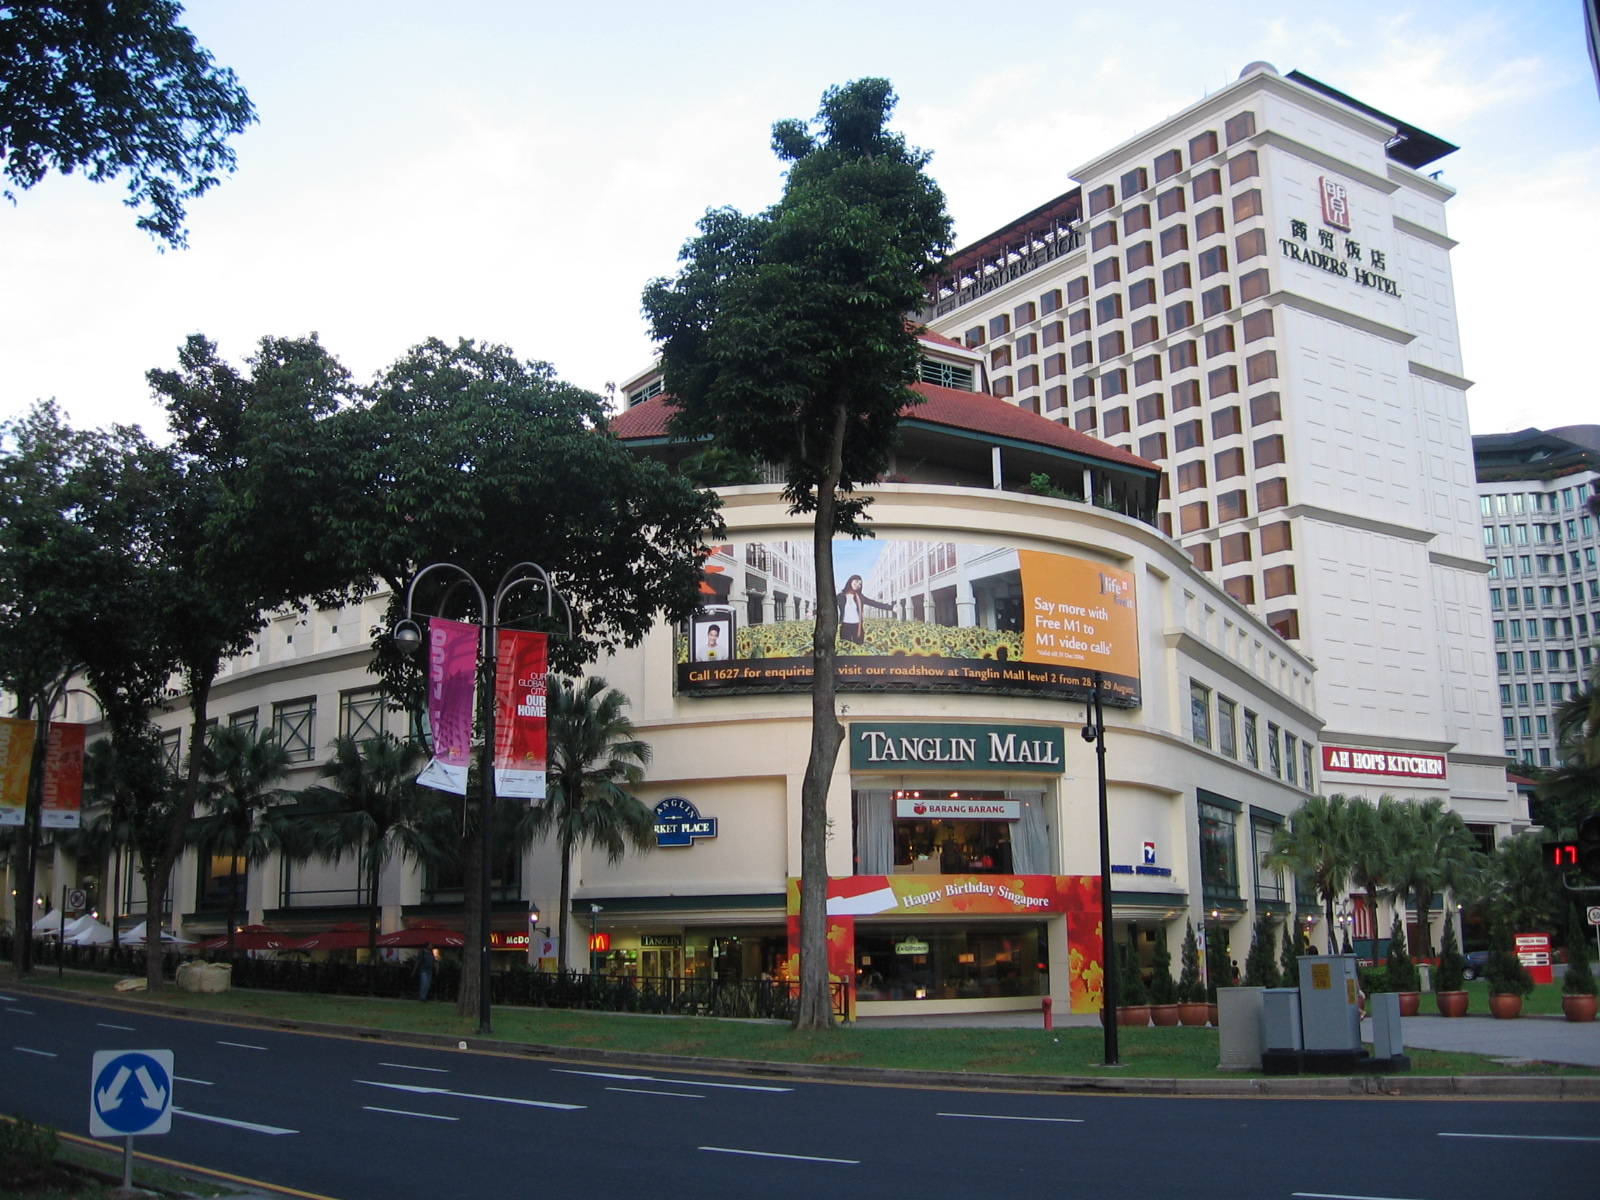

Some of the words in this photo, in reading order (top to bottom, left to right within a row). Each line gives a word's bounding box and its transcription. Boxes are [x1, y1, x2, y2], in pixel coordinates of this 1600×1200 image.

[1279, 238, 1349, 278] TRADERS
[1354, 266, 1402, 299] HOTEL
[1034, 597, 1055, 615] Say
[1058, 603, 1085, 616] more
[1088, 606, 1108, 621] with
[1035, 615, 1060, 630] Free
[1064, 618, 1080, 632] M1
[1083, 624, 1094, 635] to
[1036, 633, 1055, 646] M1
[1059, 635, 1088, 651] video
[518, 679, 547, 688] GLOBAL
[530, 672, 547, 681] OUR
[689, 669, 710, 682] Call
[714, 669, 739, 680] 1627
[743, 667, 761, 679] for
[838, 664, 862, 675] visit
[866, 666, 885, 675] our
[889, 664, 943, 676] roadshow
[948, 667, 958, 677] at
[962, 667, 1000, 681] Tanglin
[1003, 669, 1024, 680] Mall
[1027, 672, 1049, 682] level
[1051, 673, 1056, 682] 2
[1059, 674, 1079, 685] from
[1082, 677, 1092, 687] 28
[1103, 679, 1111, 690] 29
[526, 695, 547, 707] OUR
[518, 705, 547, 718] HOME
[861, 731, 976, 762] TANGLIN
[988, 732, 1060, 765] MALL
[1330, 751, 1350, 768] AH
[1352, 752, 1385, 771] HOI'S
[1387, 755, 1443, 775] KITCHEN
[656, 799, 696, 819] ANGLIN
[929, 805, 966, 813] BARANG
[968, 805, 1005, 813] BARANG
[653, 824, 678, 833] RKET
[681, 823, 710, 833] PLACE
[1555, 845, 1578, 866] 17
[902, 889, 942, 908] Happy
[945, 881, 996, 897] Birthday
[997, 885, 1049, 908] Singapore
[643, 935, 681, 946] TANGLIN
